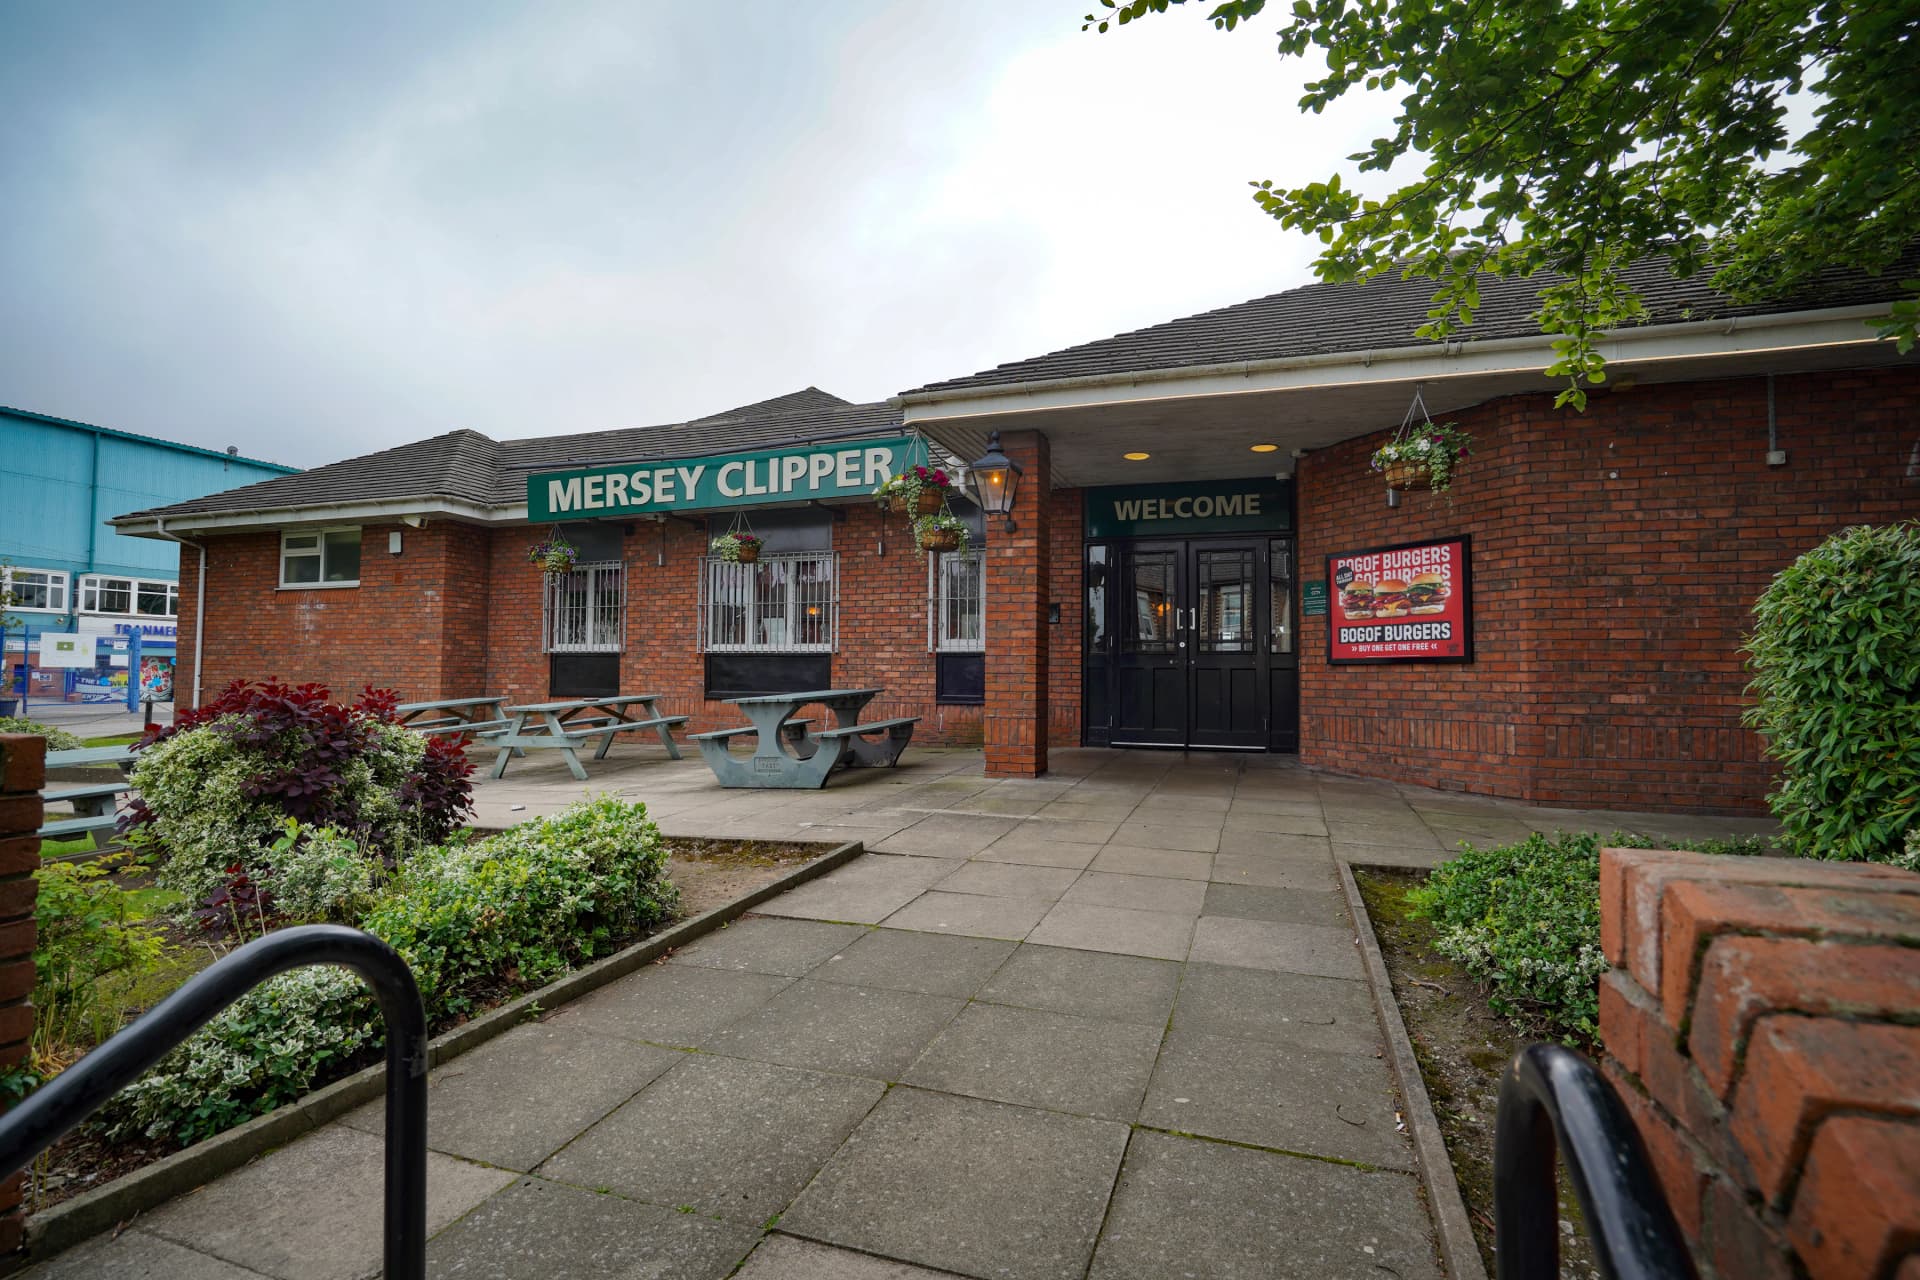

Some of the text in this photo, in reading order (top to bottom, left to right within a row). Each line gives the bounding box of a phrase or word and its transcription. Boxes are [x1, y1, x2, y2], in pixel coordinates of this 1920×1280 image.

[548, 447, 894, 513] MERSEY CLIPPER
[1113, 493, 1261, 521] WELCOME
[1383, 546, 1451, 569] BURGERS
[1340, 622, 1451, 642] BOGOF BURGERS
[1358, 642, 1428, 652] BUY ONE GET ONE FREE
